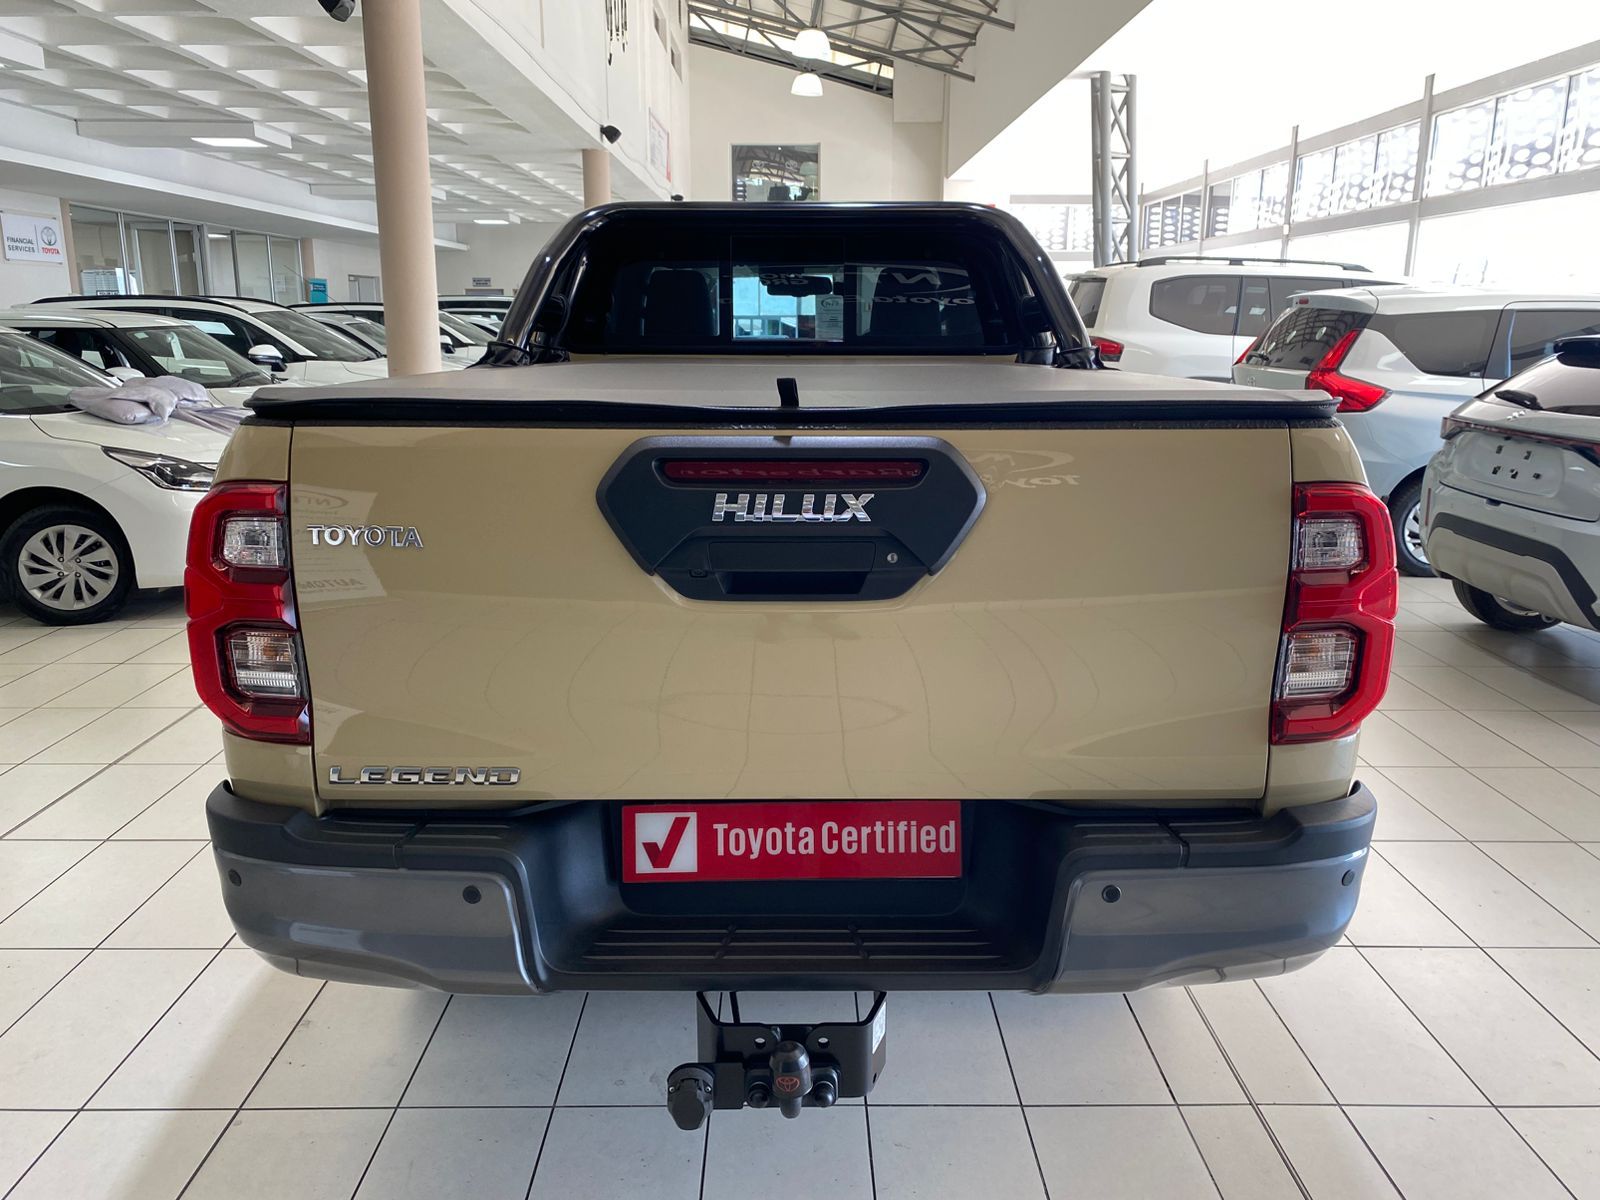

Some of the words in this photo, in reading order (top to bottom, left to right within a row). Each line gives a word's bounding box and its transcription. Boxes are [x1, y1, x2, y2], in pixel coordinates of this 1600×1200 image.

[7, 236, 34, 244] FINANCIAL
[8, 245, 35, 253] SERVICES
[41, 247, 61, 255] TOYOTA
[711, 493, 875, 523] HILUX
[307, 524, 423, 548] TOYOTA
[328, 764, 522, 786] LEGEND
[713, 822, 815, 859] Toyota
[821, 820, 957, 855] Certified
